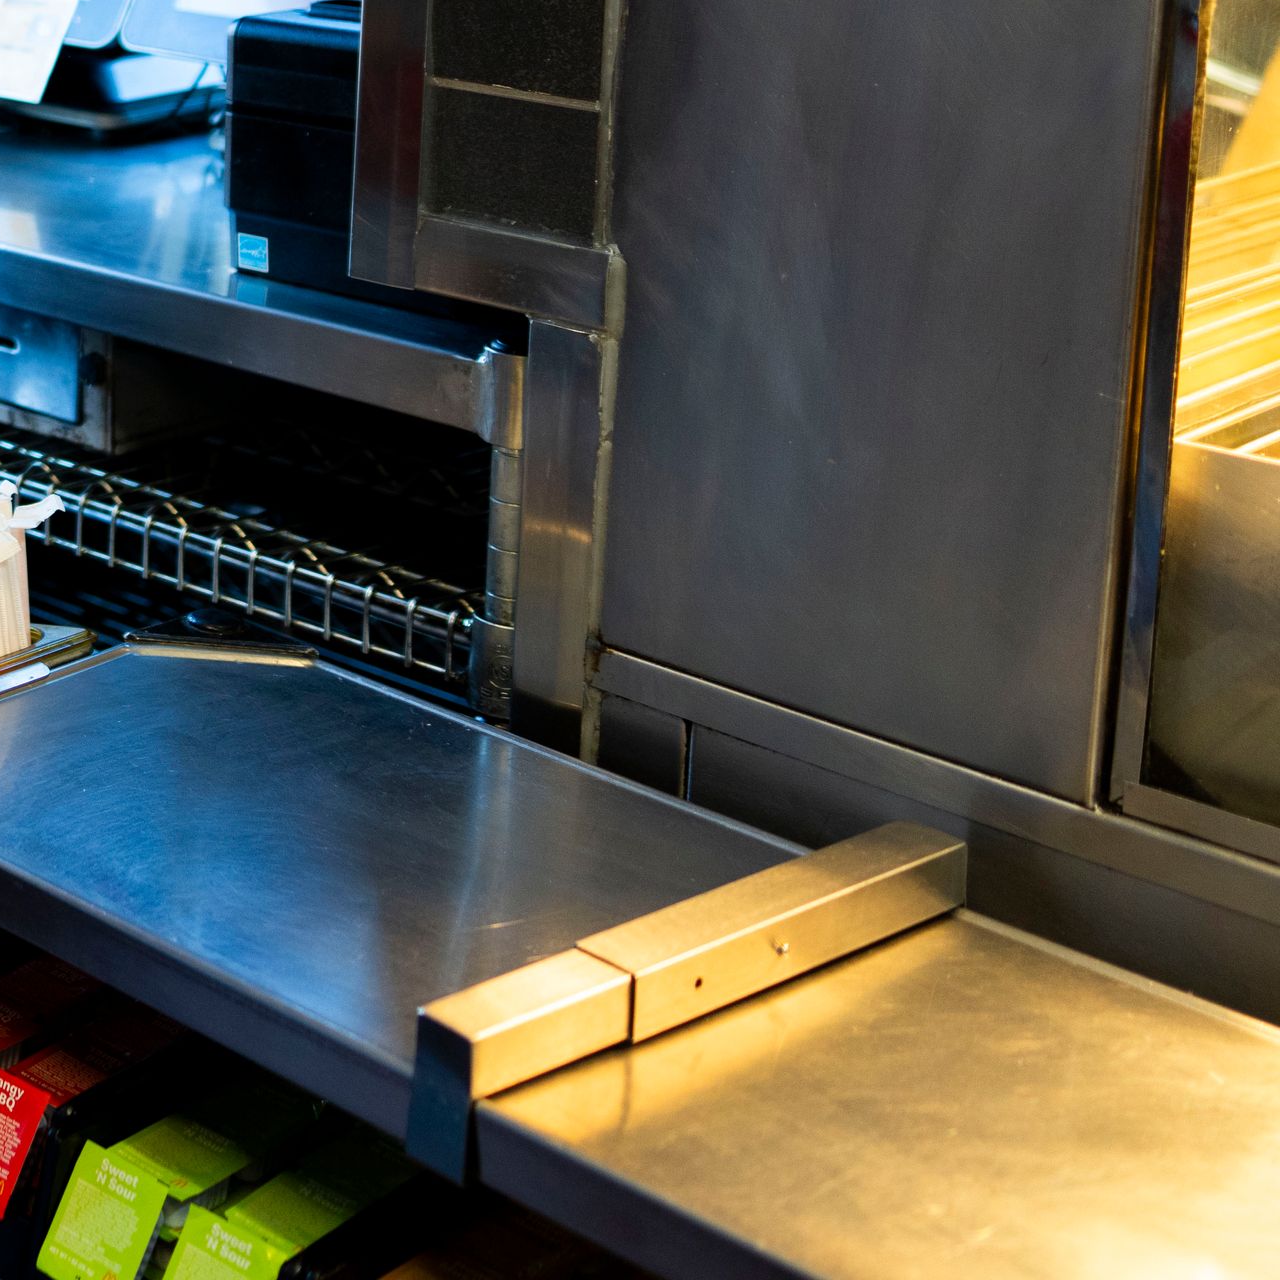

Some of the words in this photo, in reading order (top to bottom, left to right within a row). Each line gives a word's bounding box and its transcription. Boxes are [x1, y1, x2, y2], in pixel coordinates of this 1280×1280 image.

[101, 1158, 139, 1189] Sweet
[108, 1178, 137, 1202] Sour
[211, 1223, 253, 1255] Sweet
[220, 1245, 251, 1270] Sour
